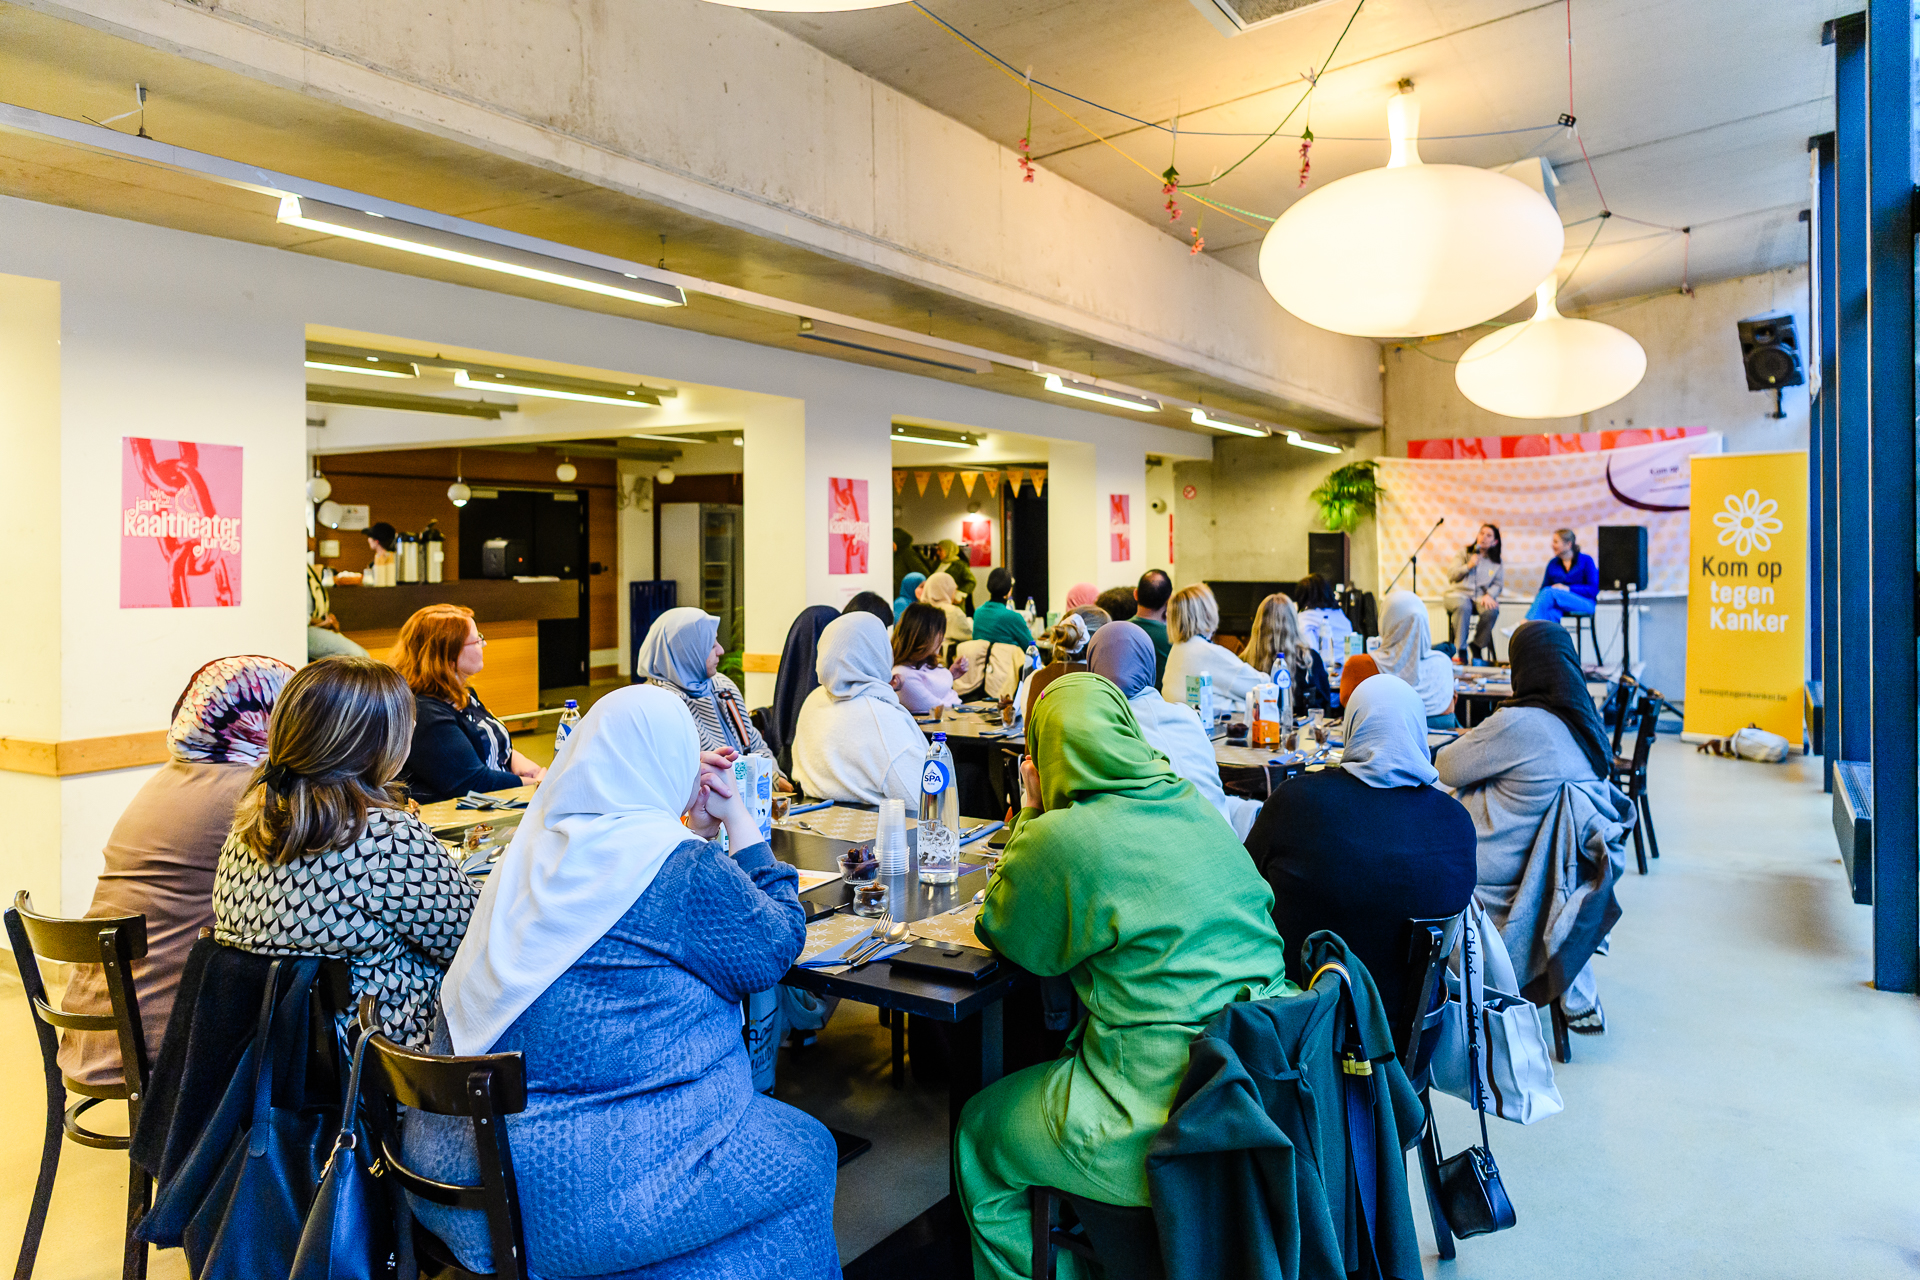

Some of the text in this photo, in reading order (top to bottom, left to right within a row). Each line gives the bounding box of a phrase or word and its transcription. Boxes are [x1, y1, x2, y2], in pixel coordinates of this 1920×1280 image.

[1702, 555, 1782, 583] Kom op
[1710, 580, 1774, 610] tegen
[1709, 606, 1789, 633] Kanker
[924, 774, 942, 783] SPA
